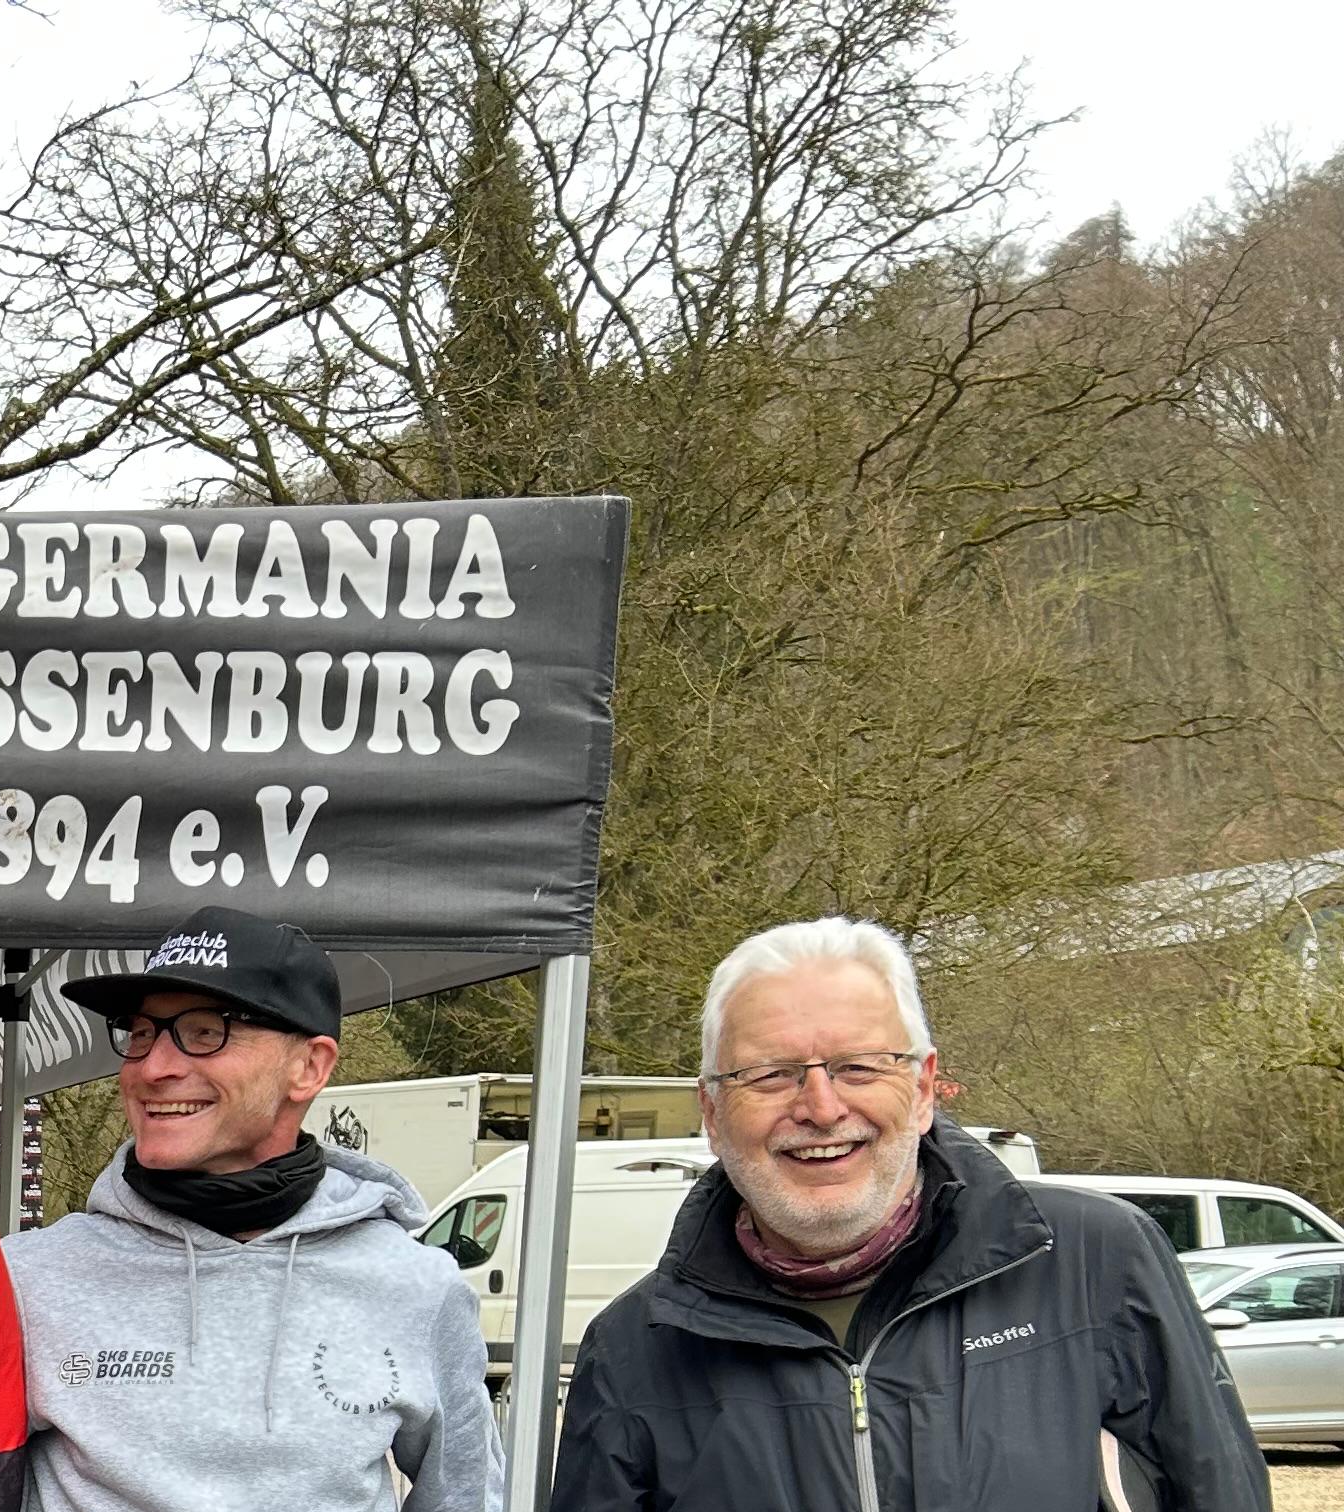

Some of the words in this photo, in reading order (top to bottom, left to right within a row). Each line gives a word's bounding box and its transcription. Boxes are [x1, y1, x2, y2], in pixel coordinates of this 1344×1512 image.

[169, 785, 330, 888] e.V.
[962, 1323, 1036, 1352] Schöffel
[96, 1363, 175, 1378] BOARDS
[97, 1350, 129, 1362] SK8
[133, 1350, 176, 1363] EDGE
[312, 1342, 360, 1415] SKATECLUB
